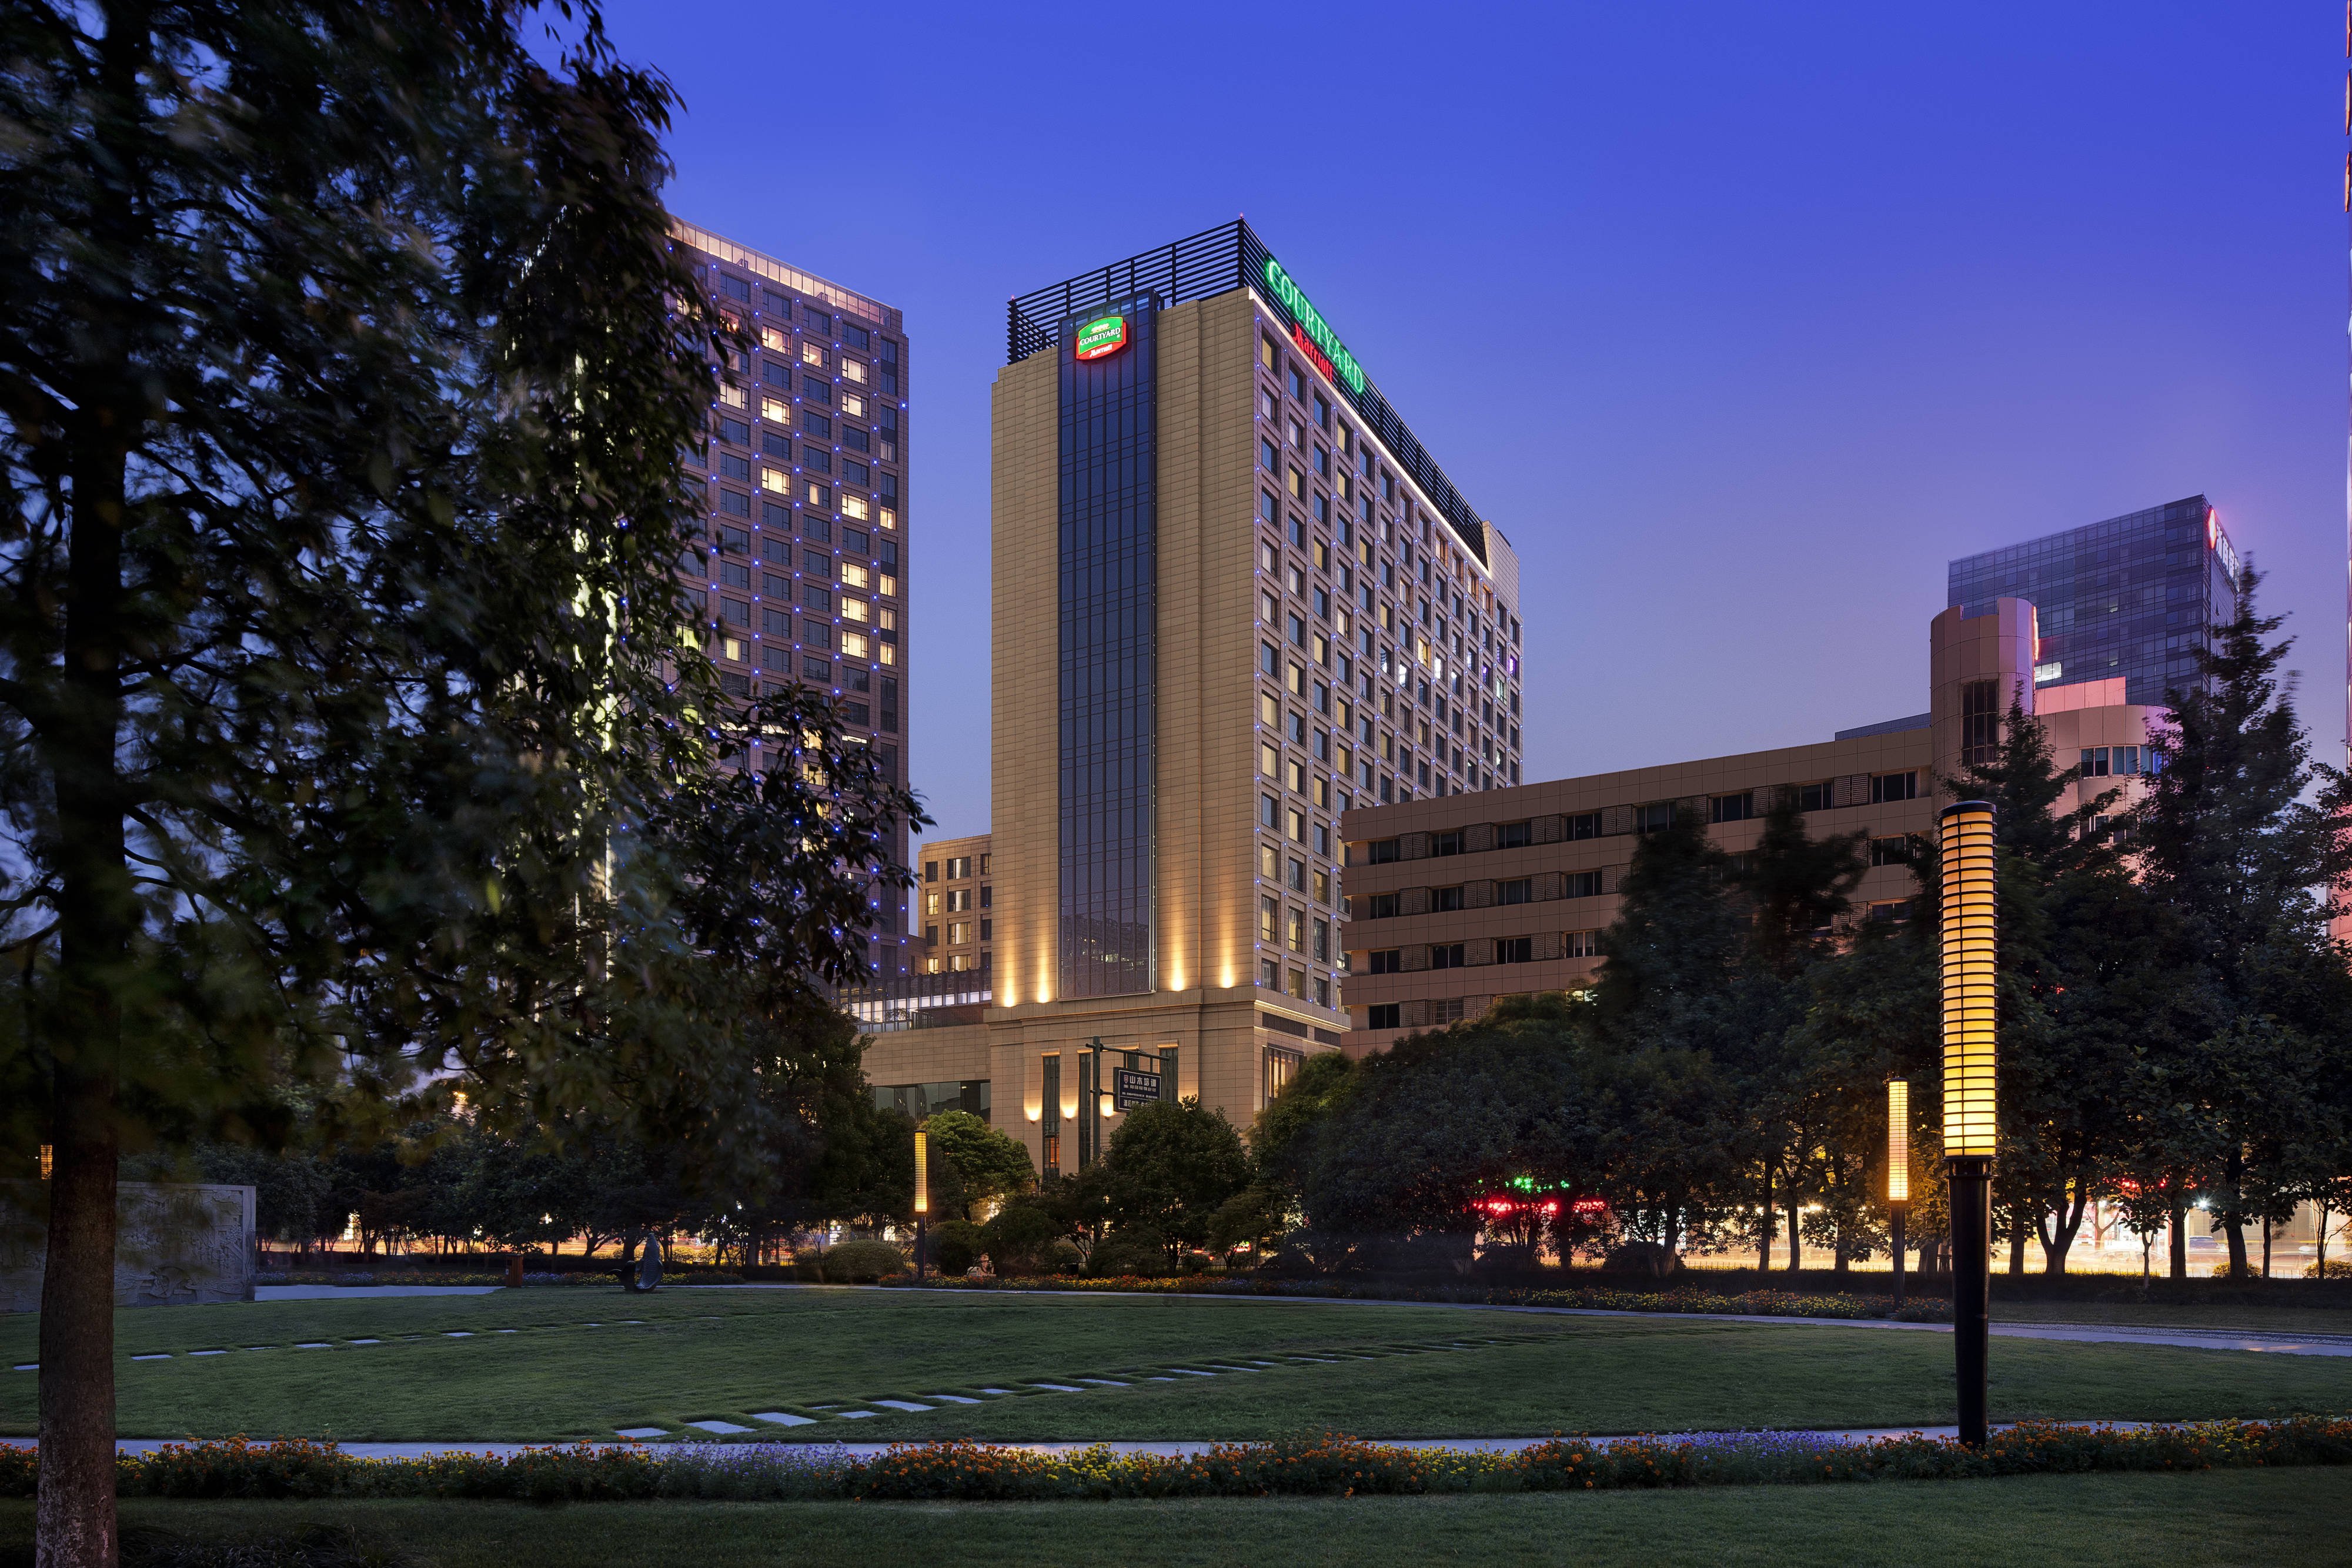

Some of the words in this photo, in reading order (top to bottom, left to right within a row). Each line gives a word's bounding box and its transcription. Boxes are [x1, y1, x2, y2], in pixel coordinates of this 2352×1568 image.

[1079, 327, 1121, 346] COURTYARD
[1268, 261, 1364, 394] COURTYARD
[1293, 322, 1333, 382] Marriott
[1130, 1075, 1157, 1087] 山木培训
